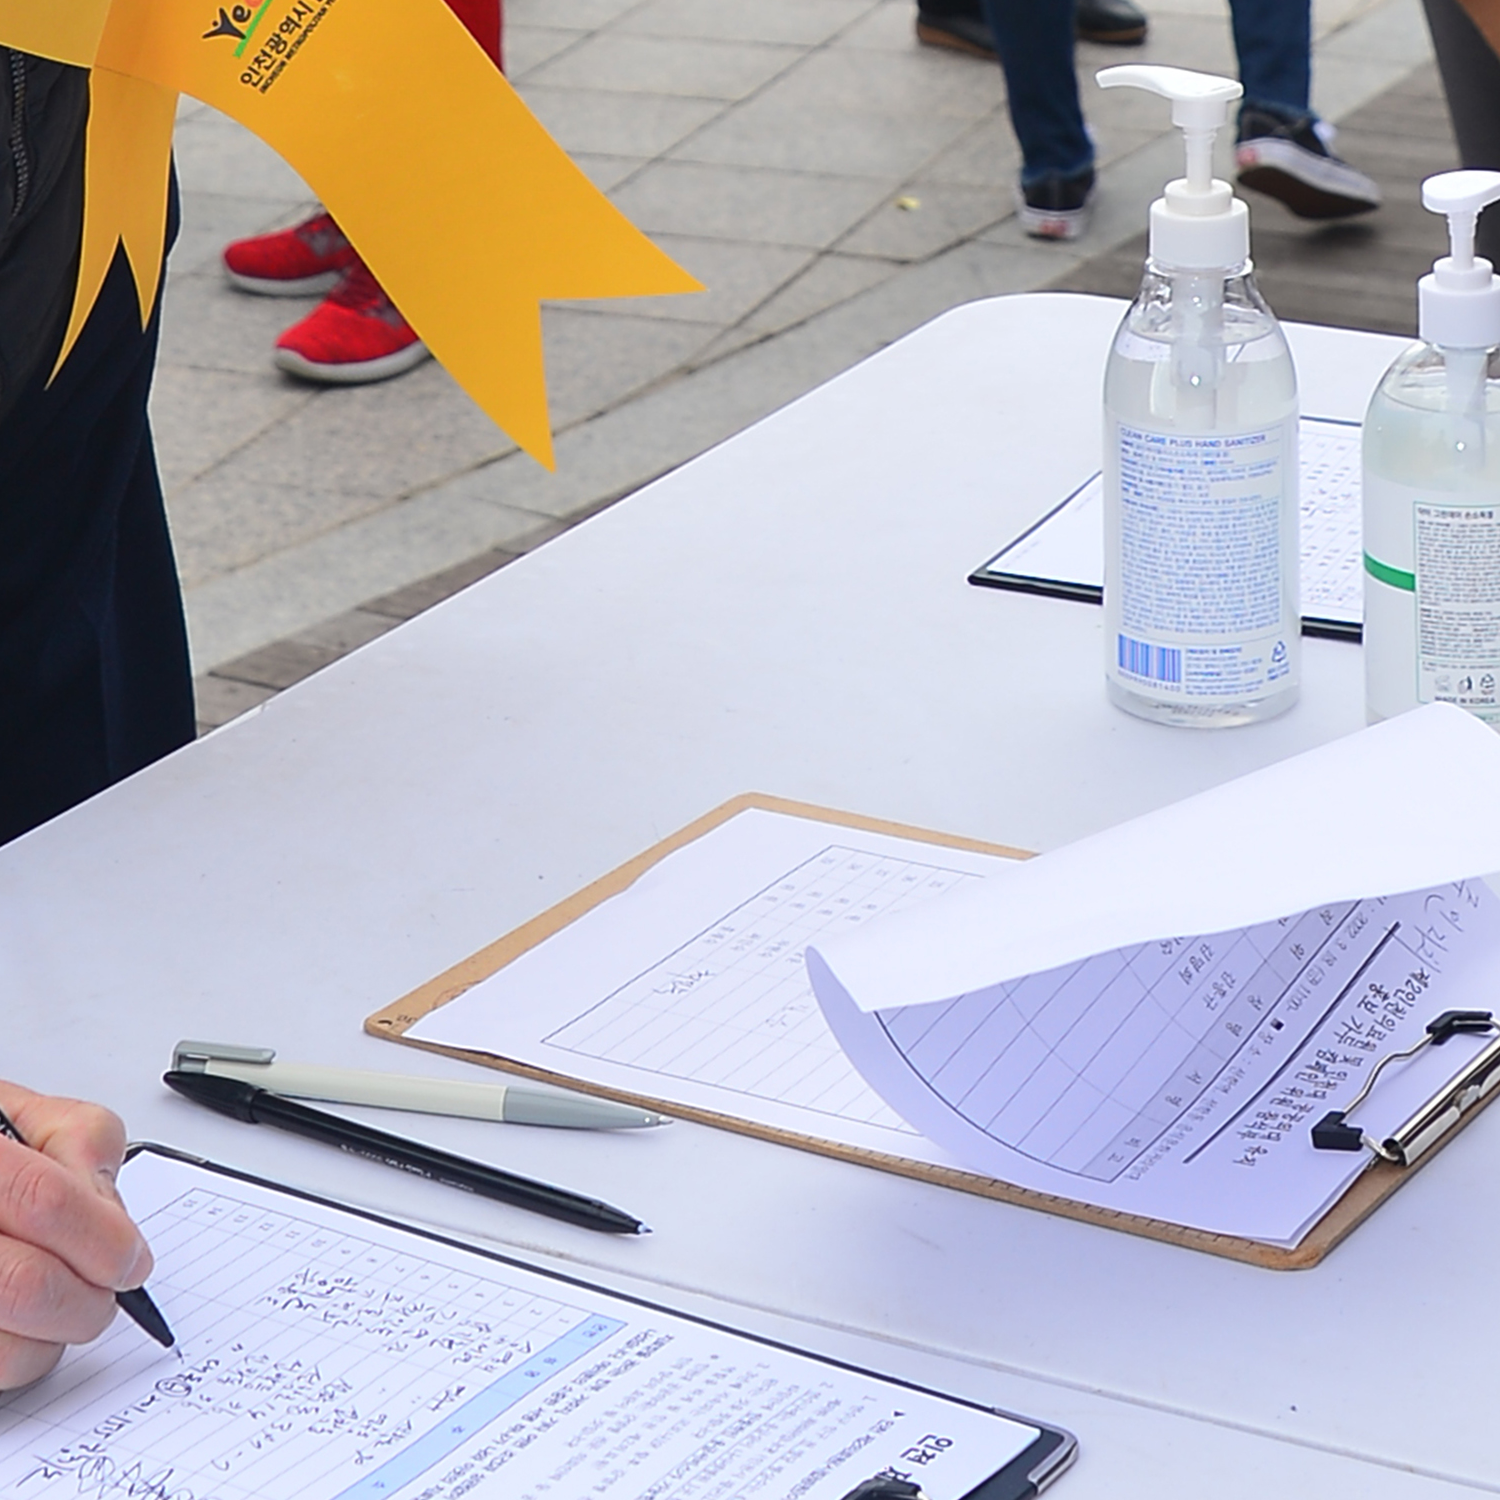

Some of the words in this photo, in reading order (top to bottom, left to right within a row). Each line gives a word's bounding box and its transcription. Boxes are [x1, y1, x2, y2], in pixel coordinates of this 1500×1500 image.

[1120, 427, 1142, 442] CLEAN
[1144, 434, 1166, 446] CARE
[1169, 437, 1192, 448] PLUS
[1195, 438, 1222, 448] HAND
[1224, 434, 1266, 448] SANITIZER
[1353, 969, 1429, 1051] 제2인천의료원
[1357, 983, 1390, 1015] 홍보
[901, 1434, 953, 1466] 인천
